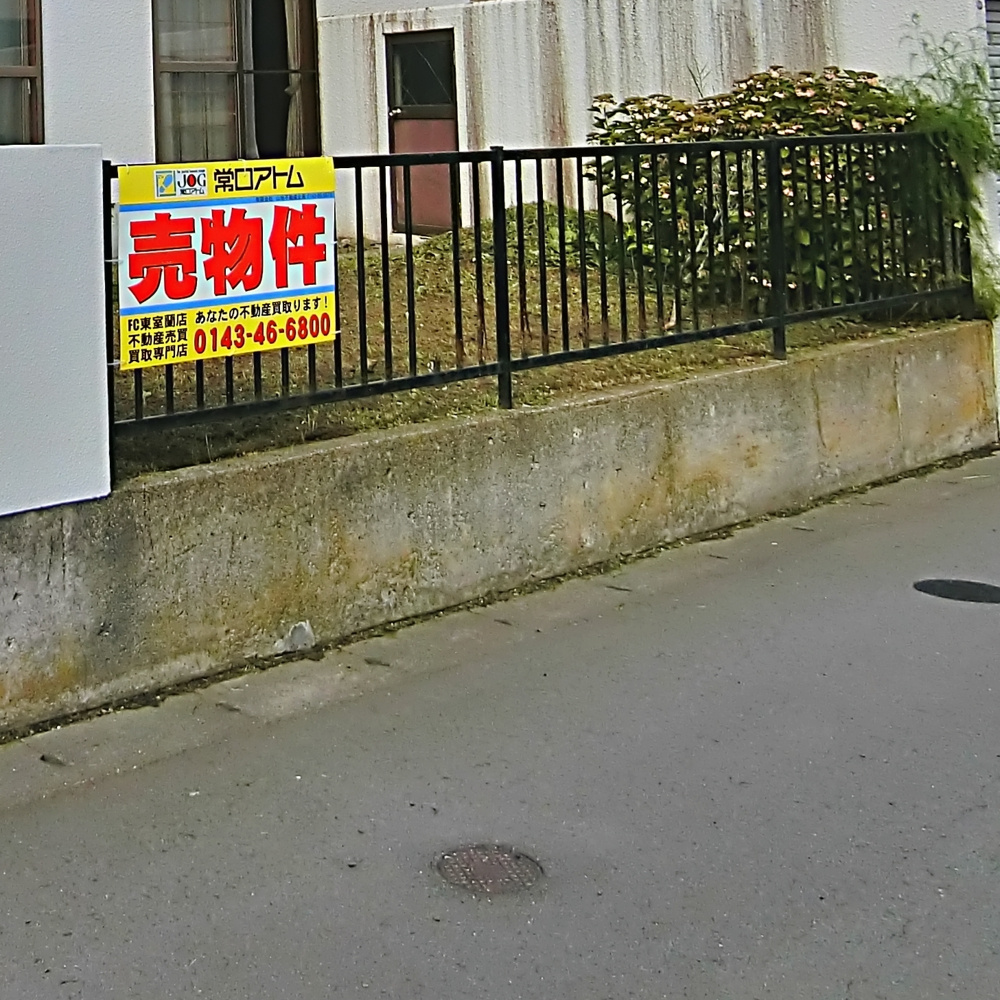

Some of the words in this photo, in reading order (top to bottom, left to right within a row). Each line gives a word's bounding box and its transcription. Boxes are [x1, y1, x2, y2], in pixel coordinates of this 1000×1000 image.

[177, 173, 206, 188] JOG
[214, 164, 304, 193] 常口アトム
[128, 203, 327, 304] 売物件
[195, 295, 328, 324] あなたの不動産買取ります！
[128, 313, 187, 331] FC東室蘭店
[193, 312, 331, 354] 0143-46-6800
[128, 328, 188, 348] 不動産売買
[128, 344, 188, 364] 買取専門店
